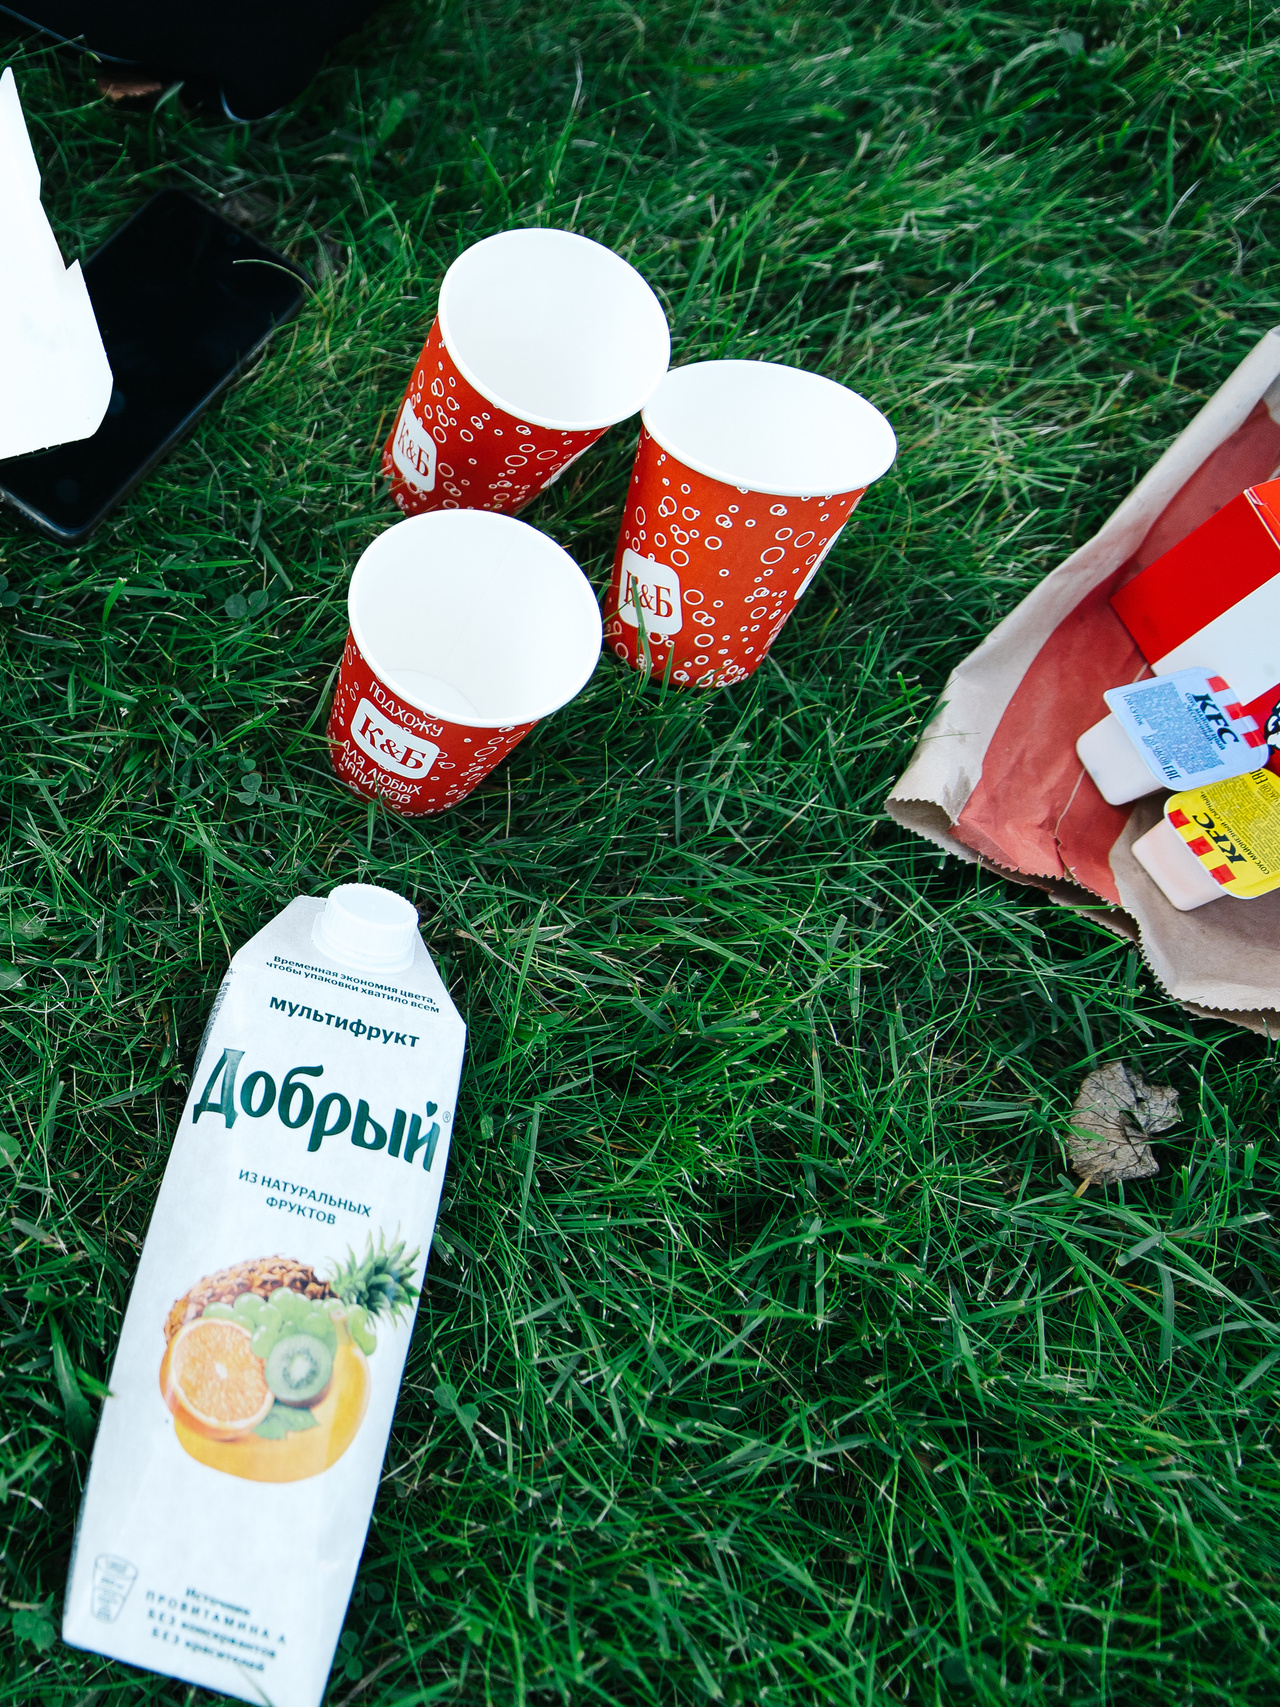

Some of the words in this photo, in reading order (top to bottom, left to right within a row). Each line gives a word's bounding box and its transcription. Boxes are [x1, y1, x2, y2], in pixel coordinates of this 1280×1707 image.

[397, 418, 430, 477] К&Б
[623, 569, 674, 618] К&Б
[368, 680, 444, 737] ПОДХОЖУ
[1191, 693, 1240, 746] KFC
[357, 712, 428, 770] К&Б
[341, 751, 412, 804] НАПИТКОВ
[342, 739, 366, 769] ДЛЯ
[367, 767, 423, 796] ЛЮБЫХ
[1192, 812, 1248, 864] KFC
[1220, 821, 1258, 864] МАЙОНЕЗНЫЙ
[1254, 859, 1270, 875] СОУС
[266, 961, 302, 976] чтобы
[304, 971, 359, 992] упаковки
[360, 986, 409, 1005] хватило
[410, 1000, 440, 1014] всем
[273, 955, 339, 978] Временная
[340, 972, 399, 994] экономия
[399, 989, 437, 1006] цвета,
[269, 996, 421, 1048] мультифрукт
[192, 1047, 442, 1173] Добрый
[238, 1168, 258, 1184] ИЗ
[261, 1174, 372, 1218] НАТУРАЛЬНЫХ
[265, 1195, 337, 1226] ФРУКТОВ
